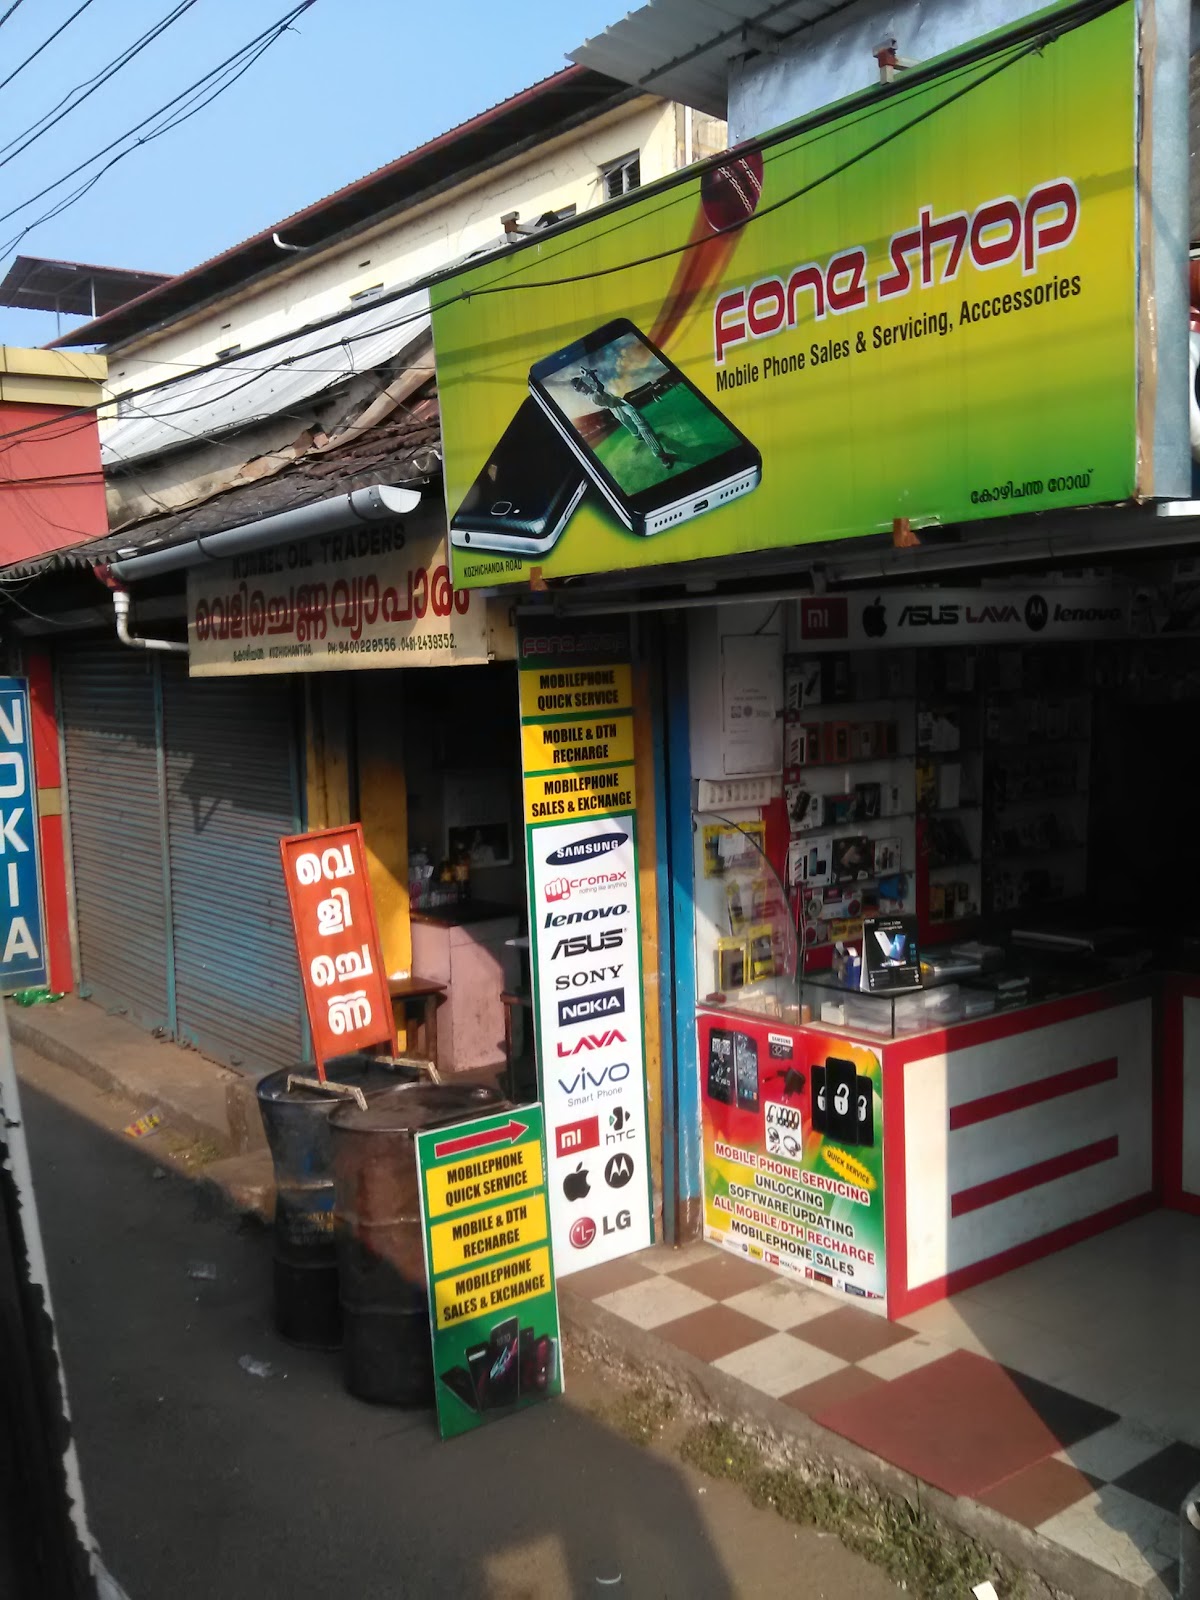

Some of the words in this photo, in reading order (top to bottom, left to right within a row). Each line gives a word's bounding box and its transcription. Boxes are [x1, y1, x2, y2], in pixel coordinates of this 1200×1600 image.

[716, 362, 759, 392] Mobile
[763, 350, 805, 379] Phone
[810, 337, 850, 367] Sales
[855, 330, 867, 353] &
[872, 309, 954, 349] Servicing,
[959, 275, 1082, 325] Acccessories
[1048, 468, 1095, 493] റോഡ്
[321, 522, 406, 563] TRADERS
[463, 561, 505, 578] KOZHICHANDA
[505, 559, 523, 572] ROAD
[898, 605, 960, 626] ASUS
[966, 605, 1021, 624] LAVA
[1053, 603, 1122, 623] lenovo
[540, 670, 615, 689] MOBILEPHONE
[538, 694, 572, 711] QUICK
[575, 690, 618, 707] SERVICE
[543, 727, 583, 745] MOBILE
[585, 728, 593, 740] &
[596, 724, 616, 739] DTH
[553, 744, 609, 764] RECHARGE
[544, 773, 619, 795] MOBILEPHONE
[532, 800, 565, 817] SALES
[567, 801, 575, 812] &
[578, 791, 631, 811] EXCHANGE
[556, 839, 619, 859] SAMSUNG
[543, 904, 628, 929] lenovo
[550, 929, 624, 960] ASUS
[555, 964, 624, 991] SONY
[562, 995, 621, 1020] NOKIA
[557, 1029, 627, 1058] LAVA
[567, 1094, 594, 1107] Smart
[597, 1086, 623, 1100] Phone
[447, 1150, 523, 1186] MOBILEPHONE
[715, 1143, 756, 1167] MOBILE
[759, 1157, 799, 1181] PHONE
[802, 1172, 869, 1204] SERVICING
[826, 1151, 845, 1167] QUICK
[845, 1163, 871, 1185] SERVICE
[445, 1182, 481, 1207] QUICK
[483, 1170, 528, 1195] SERVICE
[756, 1174, 823, 1208] UNLOCKING
[452, 1219, 493, 1241] MOBILE
[496, 1213, 504, 1227] &
[506, 1205, 527, 1224] DTH
[602, 1209, 631, 1236] LG
[730, 1184, 789, 1214] SOFTWARE
[793, 1206, 854, 1237] UPDATING
[463, 1228, 520, 1259] RECHARGE
[714, 1196, 733, 1212] ALL
[736, 1203, 804, 1239] MOBILE/DTH
[807, 1230, 875, 1265] RECHARGE
[731, 1220, 812, 1260] MOBILEPHONE
[816, 1252, 854, 1276] SALES
[455, 1258, 531, 1297] MOBILEPHONE
[443, 1299, 478, 1322] SALES
[480, 1296, 488, 1308] &
[490, 1274, 546, 1304] EXCHANGE
